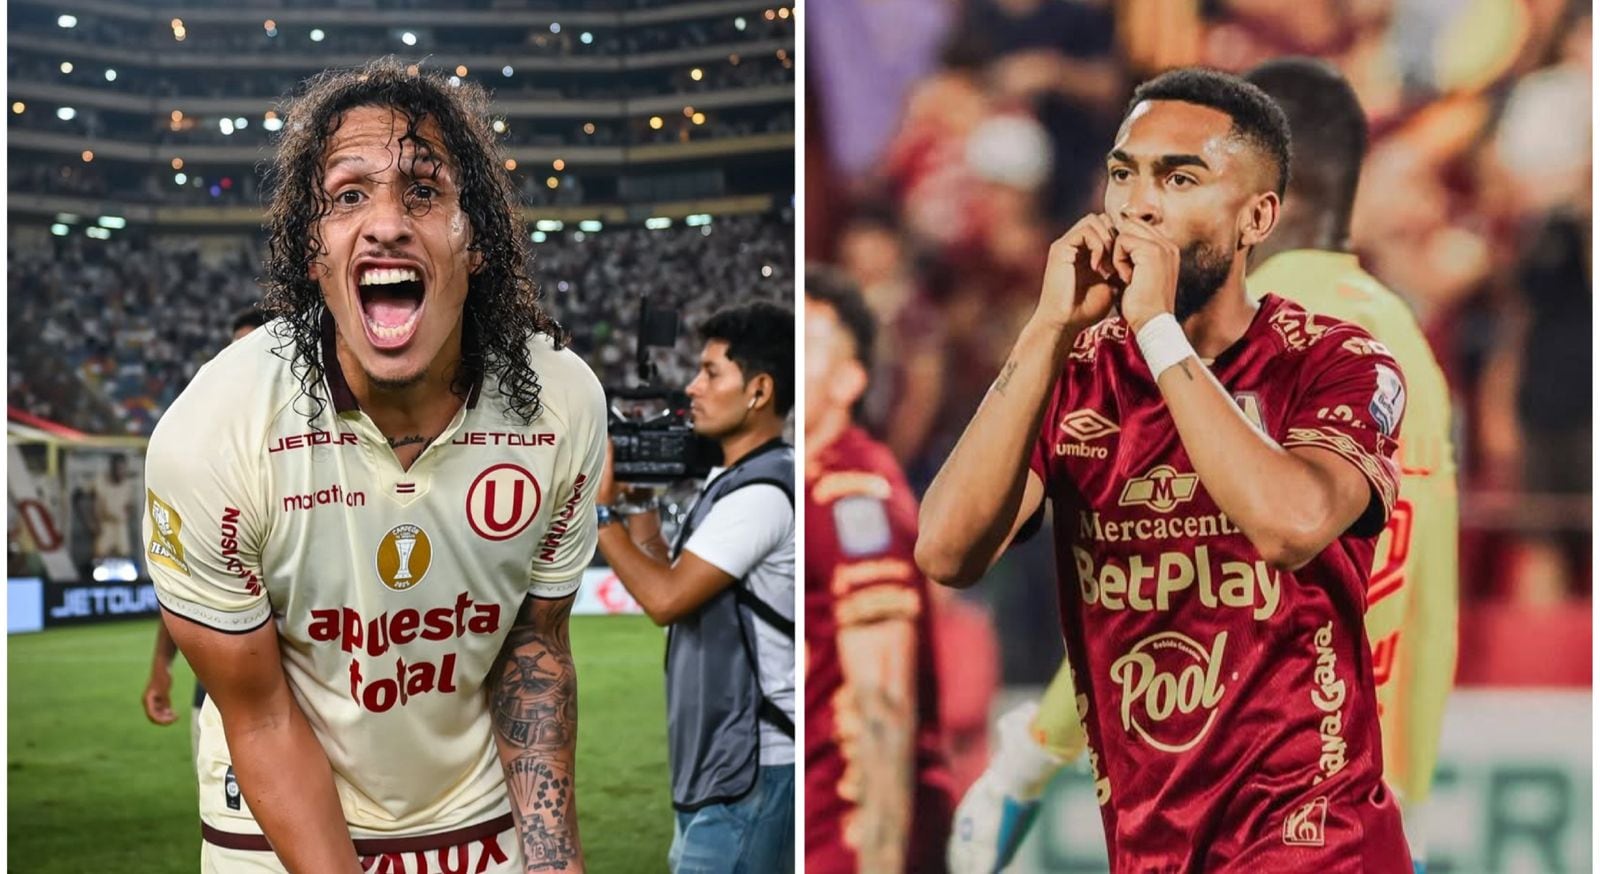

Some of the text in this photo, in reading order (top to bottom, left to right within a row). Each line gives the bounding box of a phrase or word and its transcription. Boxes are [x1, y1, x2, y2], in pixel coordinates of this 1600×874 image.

[452, 432, 556, 446] JETOUR
[1055, 443, 1109, 460] umbro
[483, 479, 525, 532] U
[1151, 477, 1174, 497] M
[1079, 509, 1241, 542] Mercacent
[1072, 545, 1281, 621] BetPlay
[308, 591, 500, 657] apuesta
[349, 653, 457, 713] total
[1110, 630, 1229, 732] Pool
